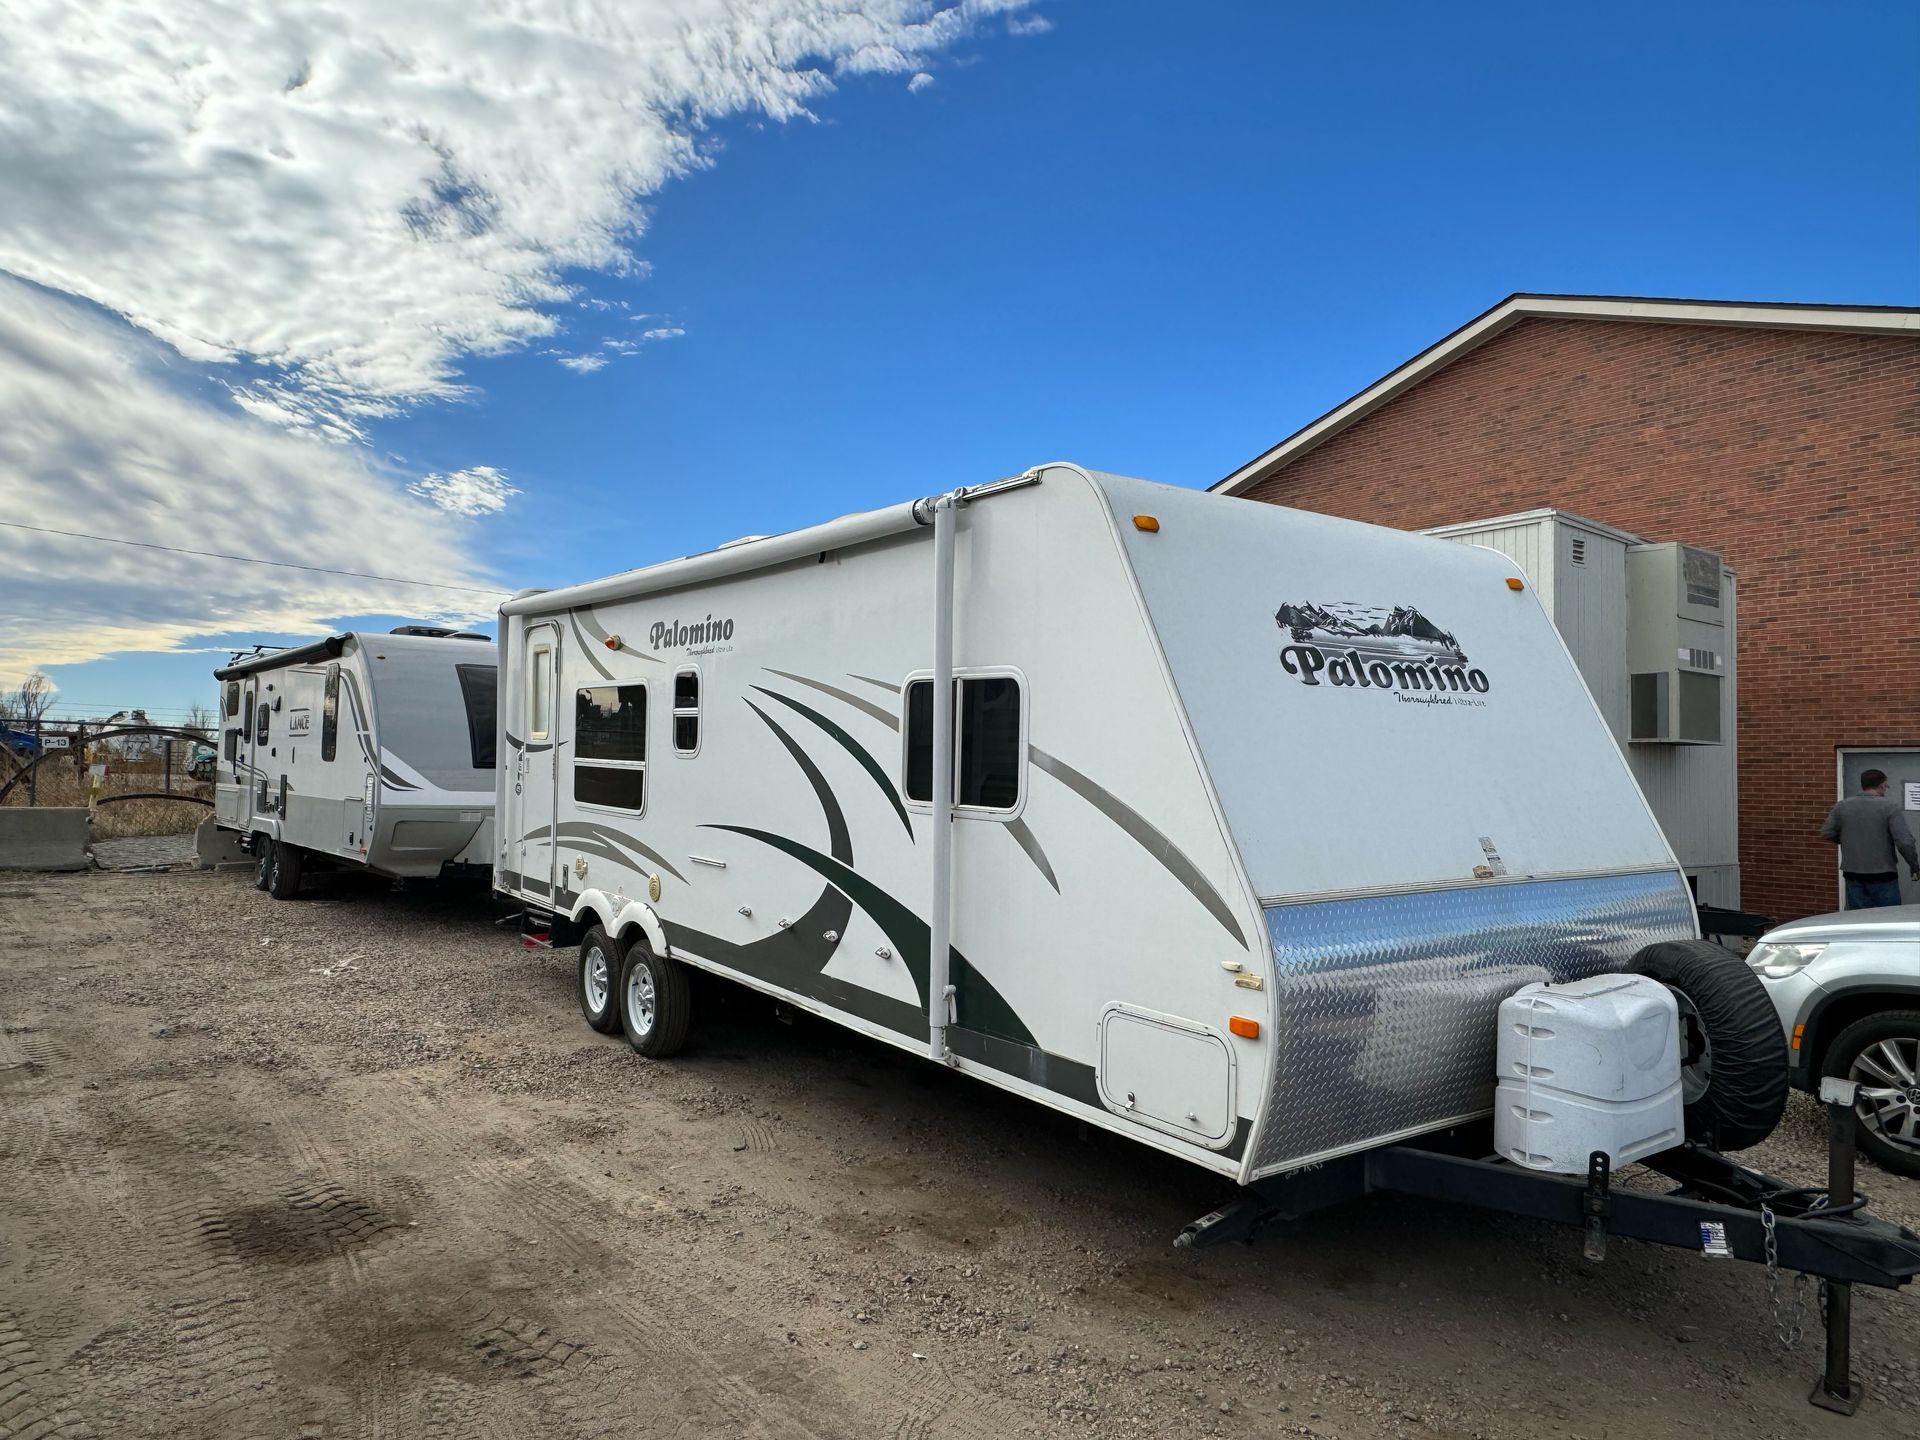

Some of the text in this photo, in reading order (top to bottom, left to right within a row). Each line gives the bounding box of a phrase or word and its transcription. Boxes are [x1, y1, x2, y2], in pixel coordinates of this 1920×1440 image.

[649, 614, 734, 650] Palomino
[1280, 645, 1490, 693] Palomino
[1393, 691, 1453, 707] Thoroughbred
